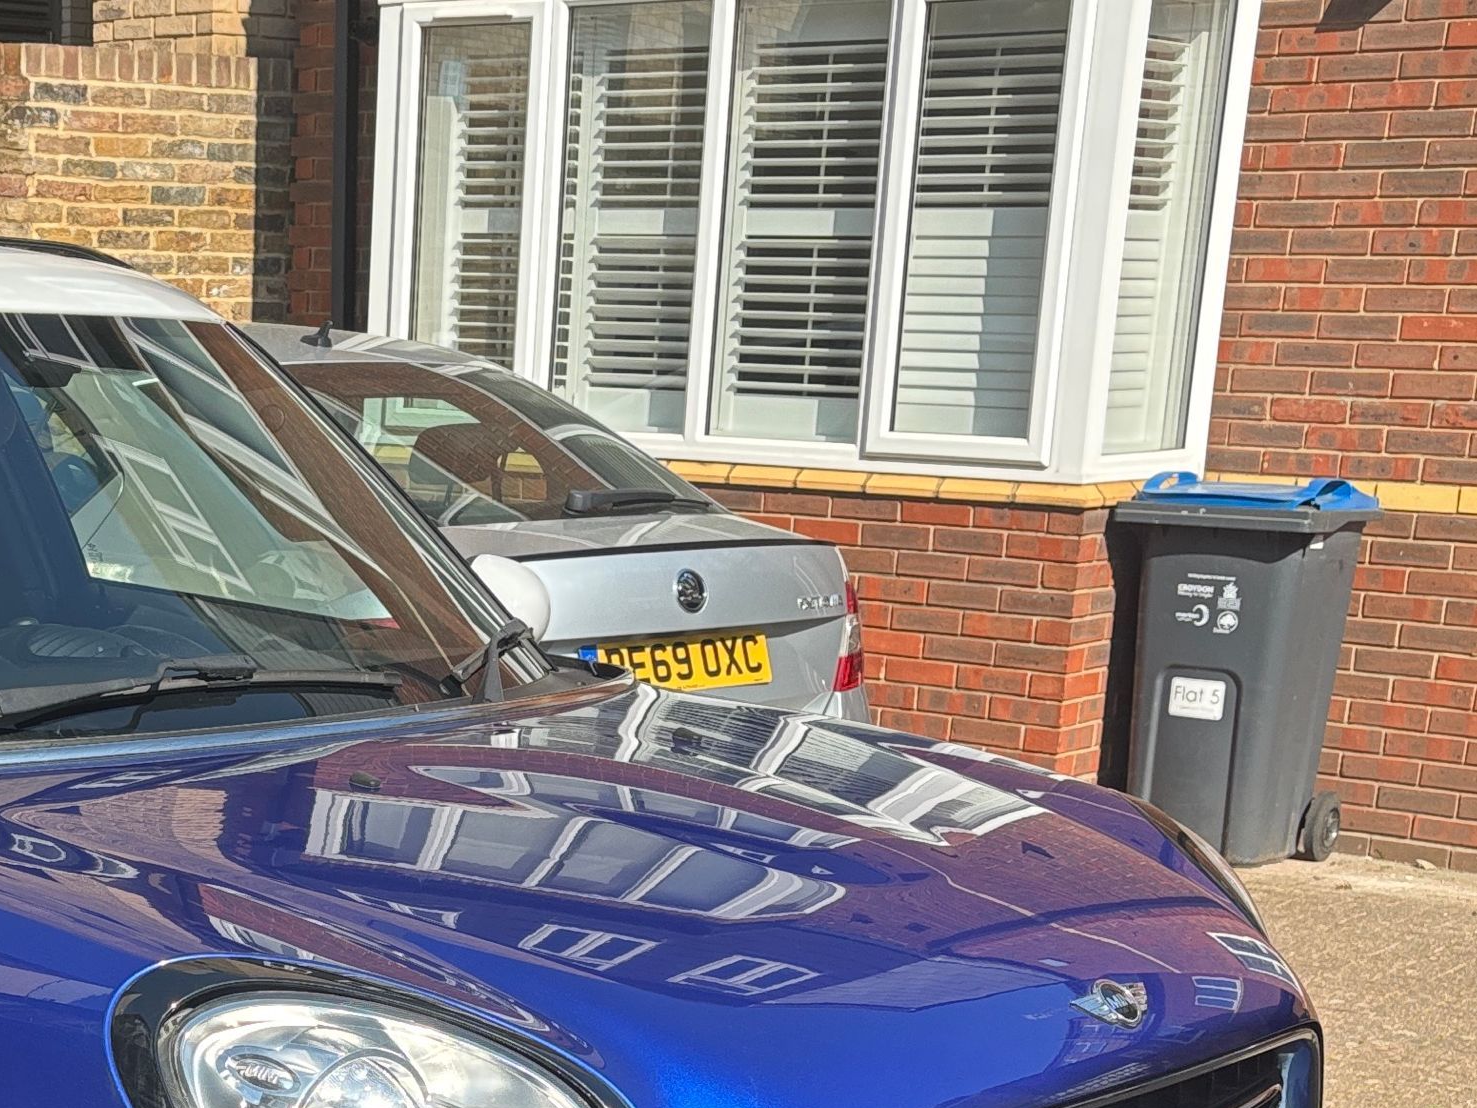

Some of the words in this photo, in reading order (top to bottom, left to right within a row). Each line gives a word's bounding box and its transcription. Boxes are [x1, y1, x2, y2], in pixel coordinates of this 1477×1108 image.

[700, 634, 763, 677] OXC
[1174, 685, 1204, 703] Flat
[1210, 688, 1221, 705] 5
